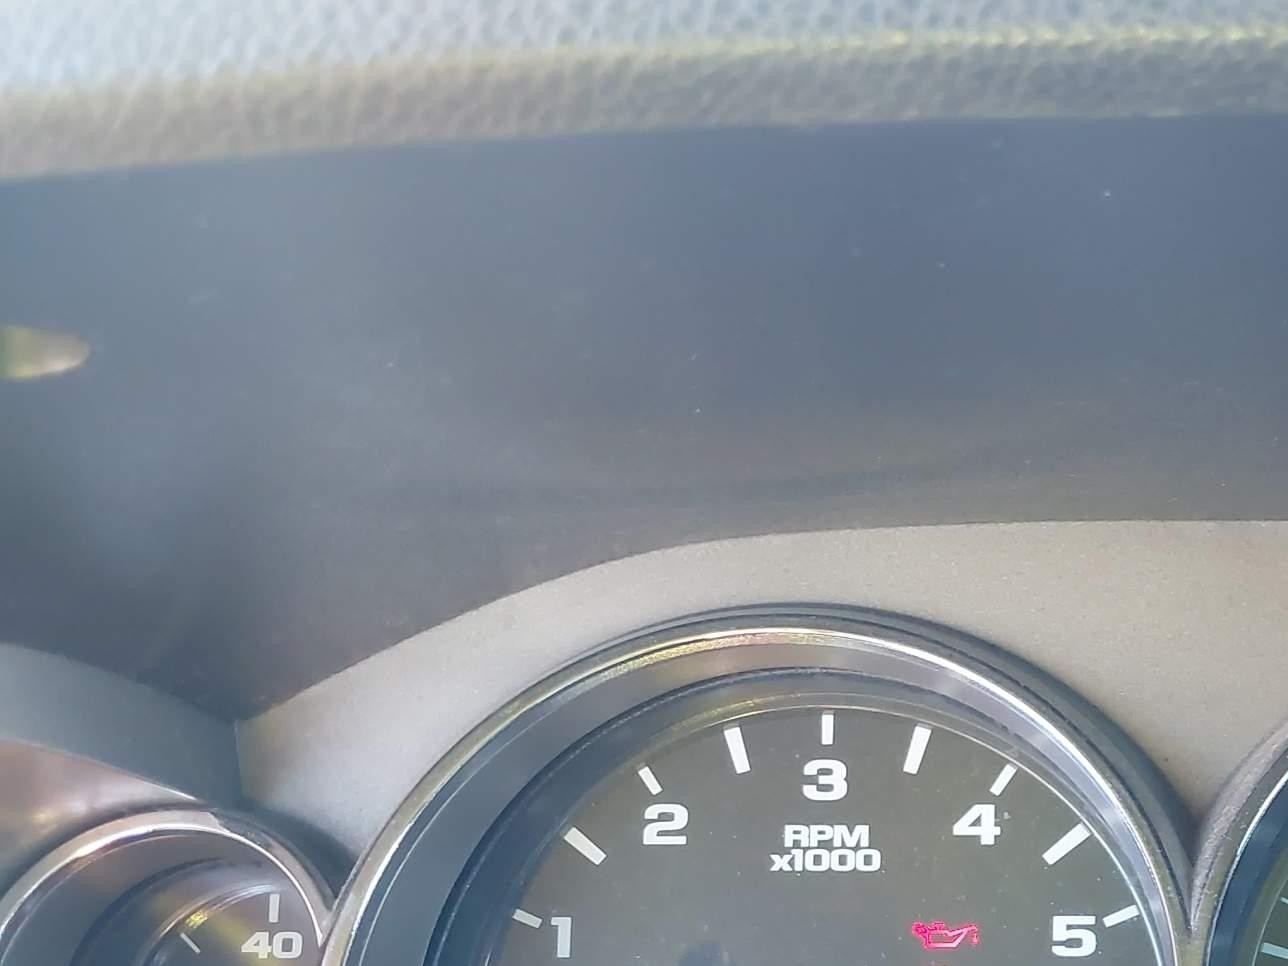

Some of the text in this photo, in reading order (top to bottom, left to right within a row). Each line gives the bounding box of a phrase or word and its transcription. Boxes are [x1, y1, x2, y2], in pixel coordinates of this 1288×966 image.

[802, 759, 848, 800] 3
[643, 804, 688, 845] 2
[784, 824, 869, 847] RPM
[952, 804, 1000, 845] 4
[769, 848, 881, 871] x1000
[241, 931, 303, 959] 40
[551, 917, 571, 957] 1
[1051, 915, 1097, 957] 5
